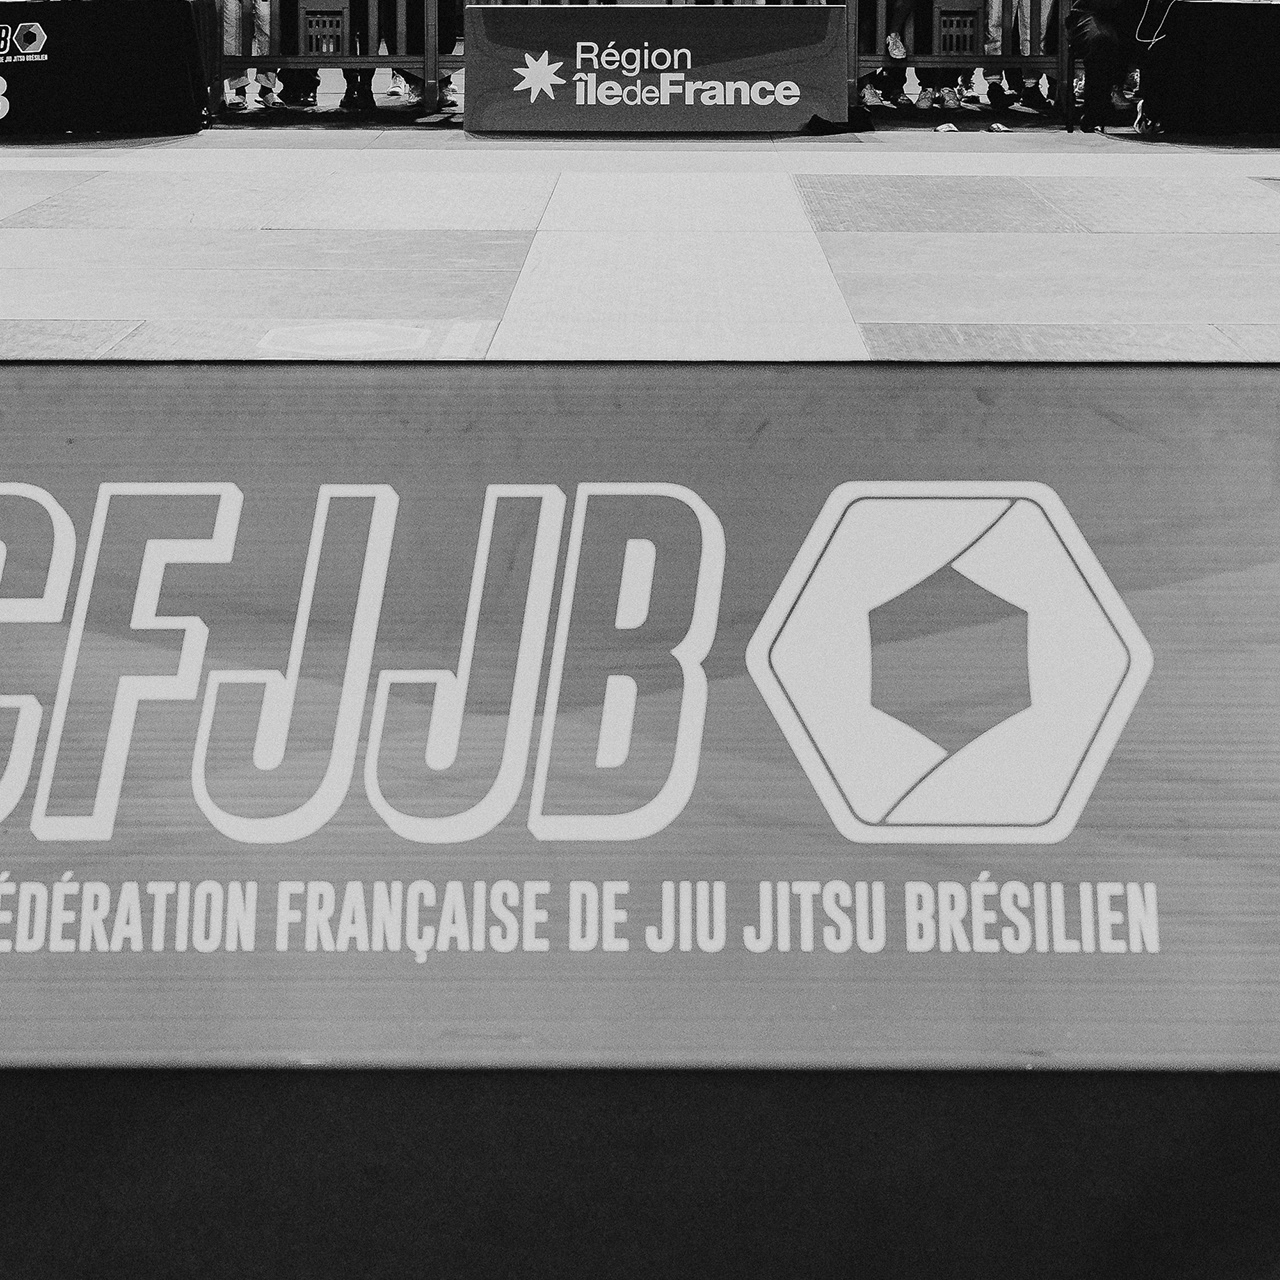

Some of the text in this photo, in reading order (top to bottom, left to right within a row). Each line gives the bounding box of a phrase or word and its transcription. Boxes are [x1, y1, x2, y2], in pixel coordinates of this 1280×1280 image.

[575, 41, 692, 77] Région
[276, 879, 551, 964] FRANÇAISE
[568, 880, 630, 953] DE
[644, 880, 727, 954] JIU
[743, 880, 887, 954] JITSU
[904, 870, 1161, 955] BRÉSILIEN
